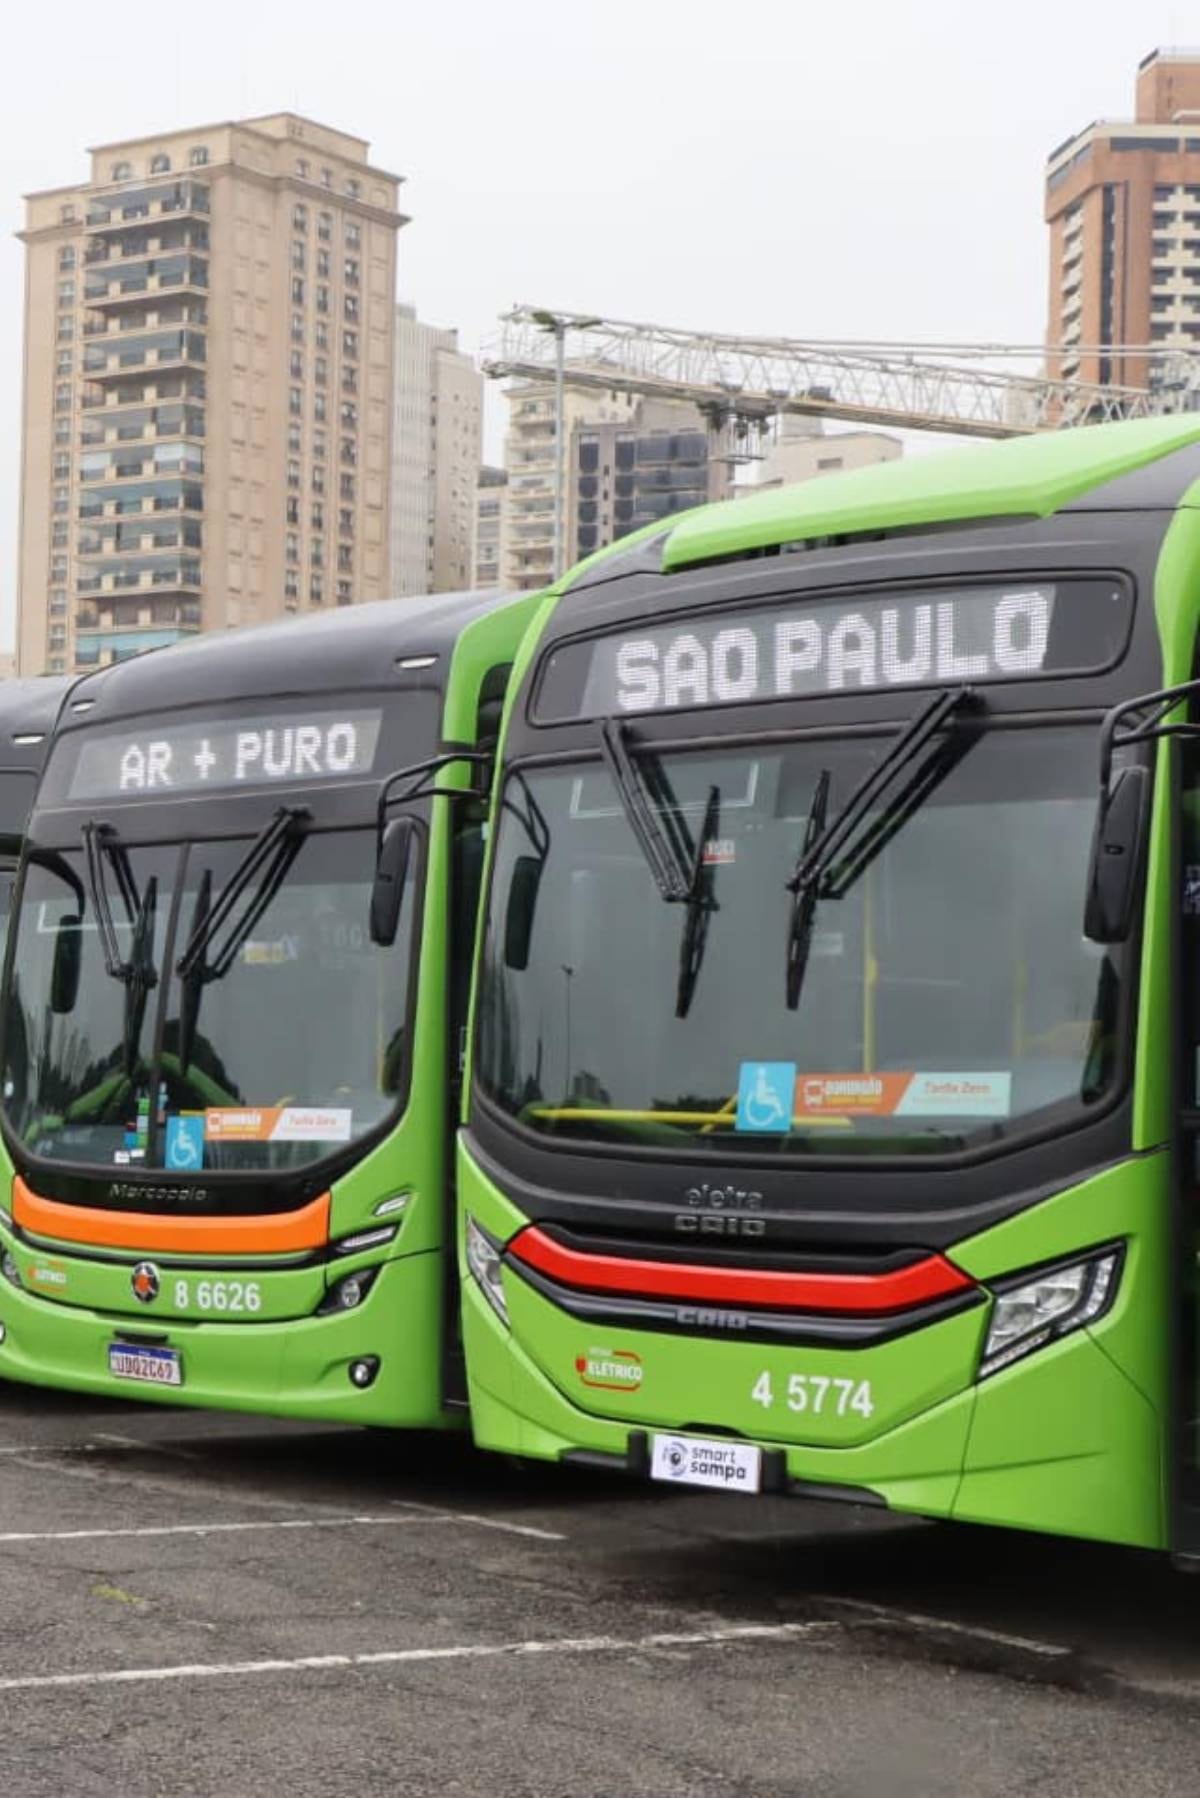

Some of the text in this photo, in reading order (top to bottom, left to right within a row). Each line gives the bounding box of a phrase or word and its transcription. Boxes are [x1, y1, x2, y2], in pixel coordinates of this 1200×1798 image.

[616, 591, 1049, 711] SAO PAULO
[119, 740, 173, 790] AR
[235, 722, 357, 779] PURO
[175, 1279, 262, 1312] 8 6626
[752, 1370, 874, 1419] 4 5774
[691, 1445, 736, 1462] smart
[691, 1460, 747, 1482] sampa
